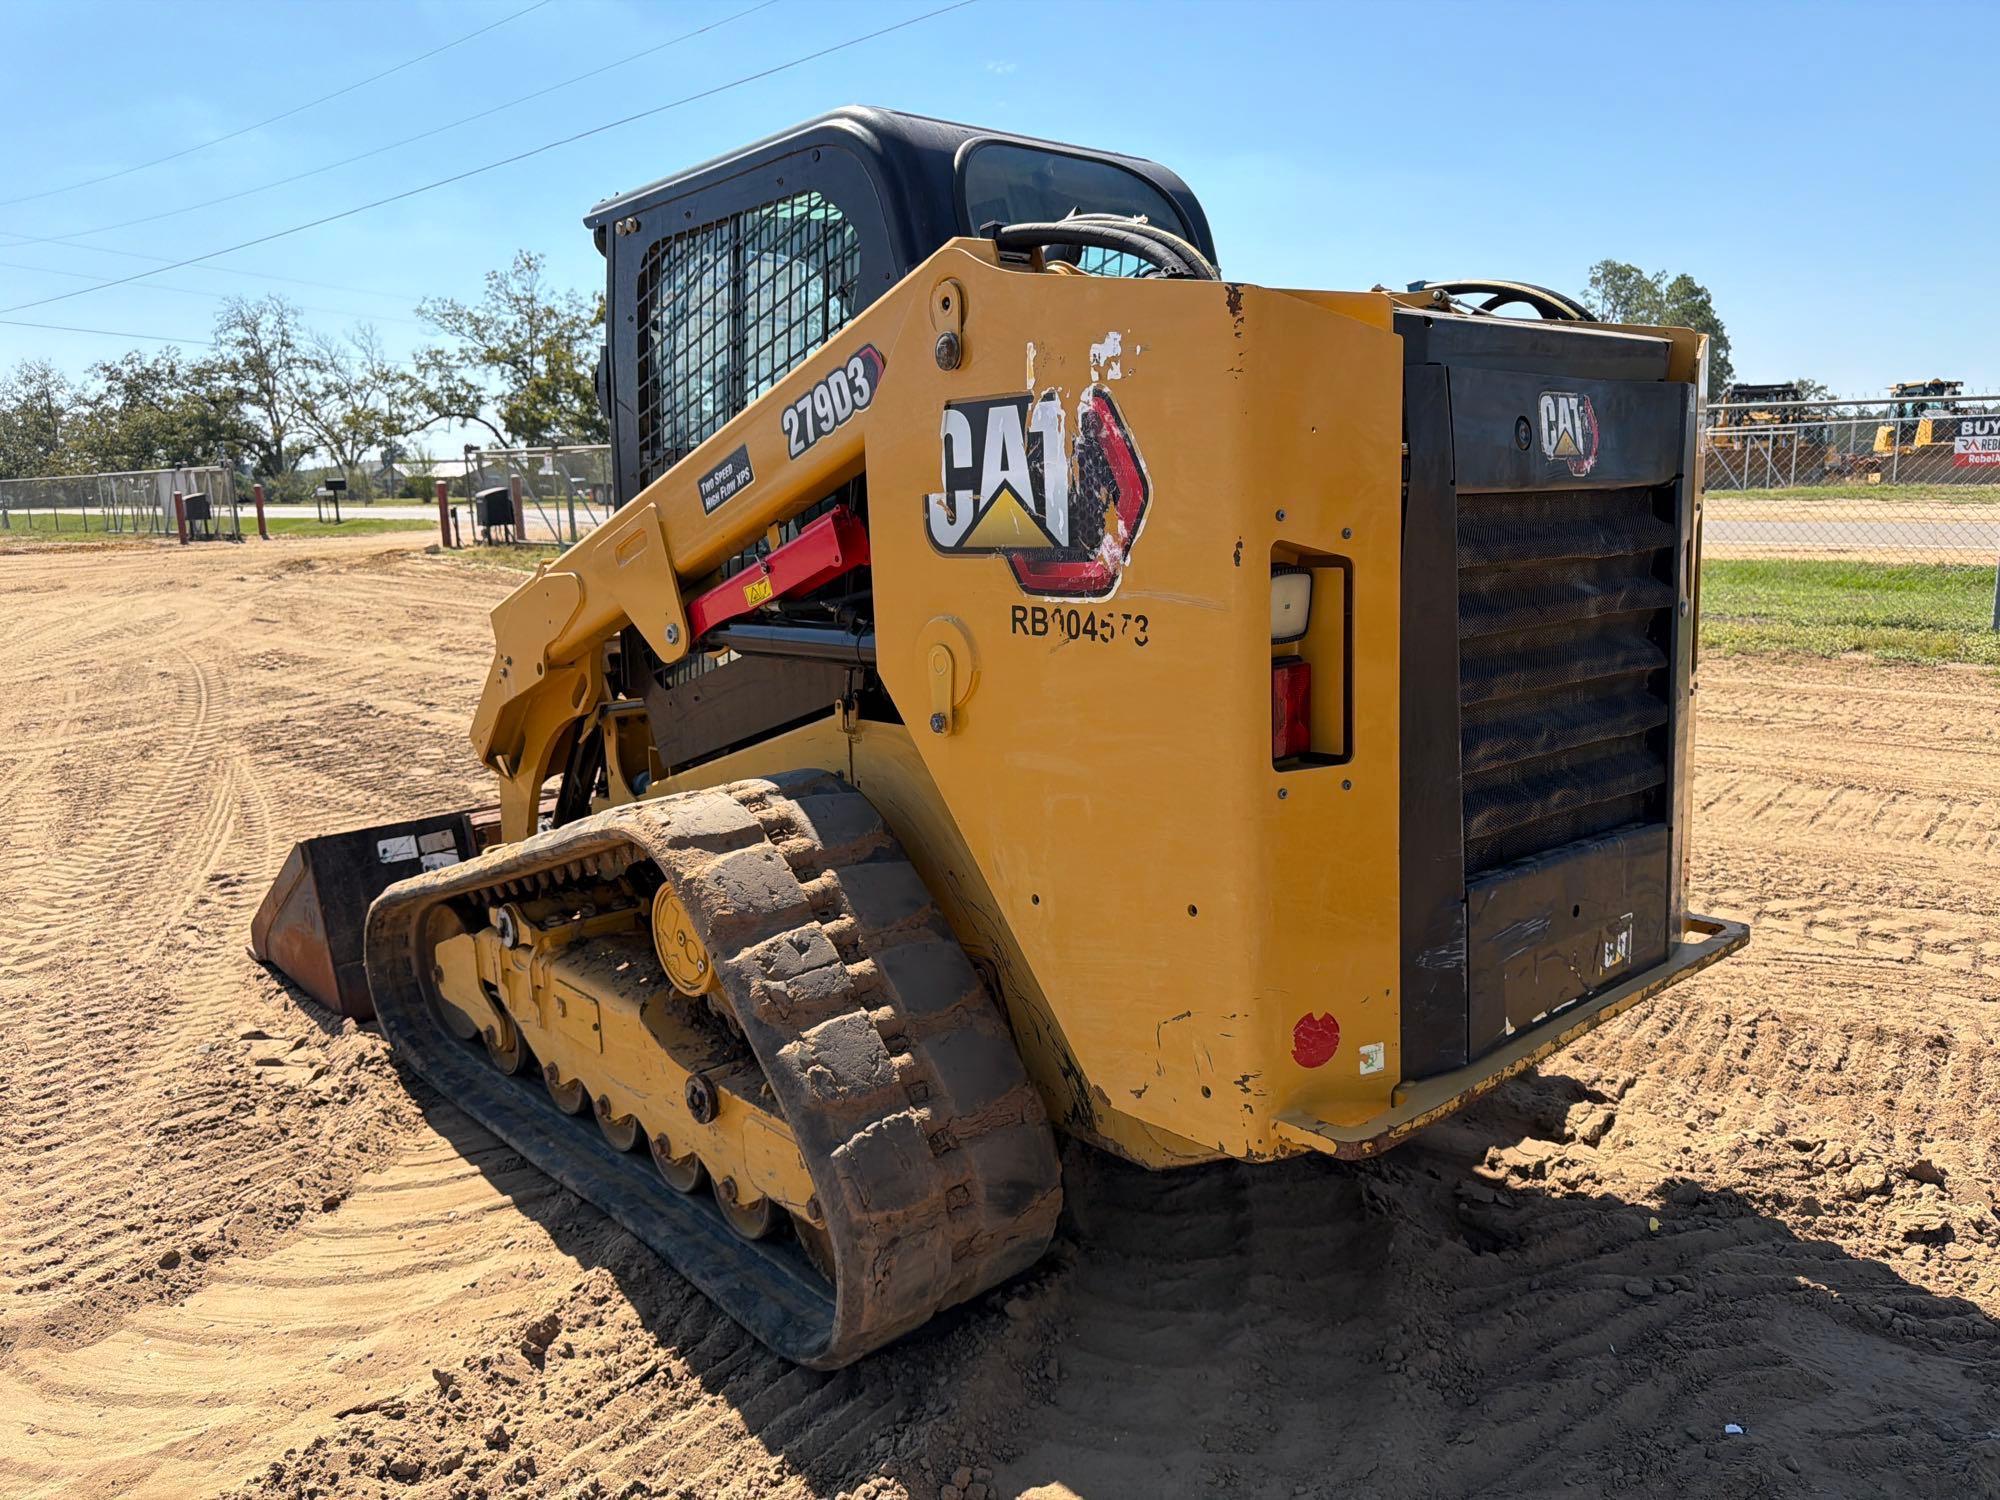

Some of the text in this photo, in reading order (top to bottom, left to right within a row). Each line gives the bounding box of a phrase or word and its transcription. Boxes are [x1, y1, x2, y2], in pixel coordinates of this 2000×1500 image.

[783, 356, 871, 457] 279D3
[1540, 395, 1584, 456] CAT
[1961, 420, 2000, 435] BUY
[1981, 438, 2000, 451] REB
[701, 463, 733, 495] TWO SPEED
[705, 466, 750, 511] HIGH FLOW XPS
[928, 402, 1069, 548] CAT
